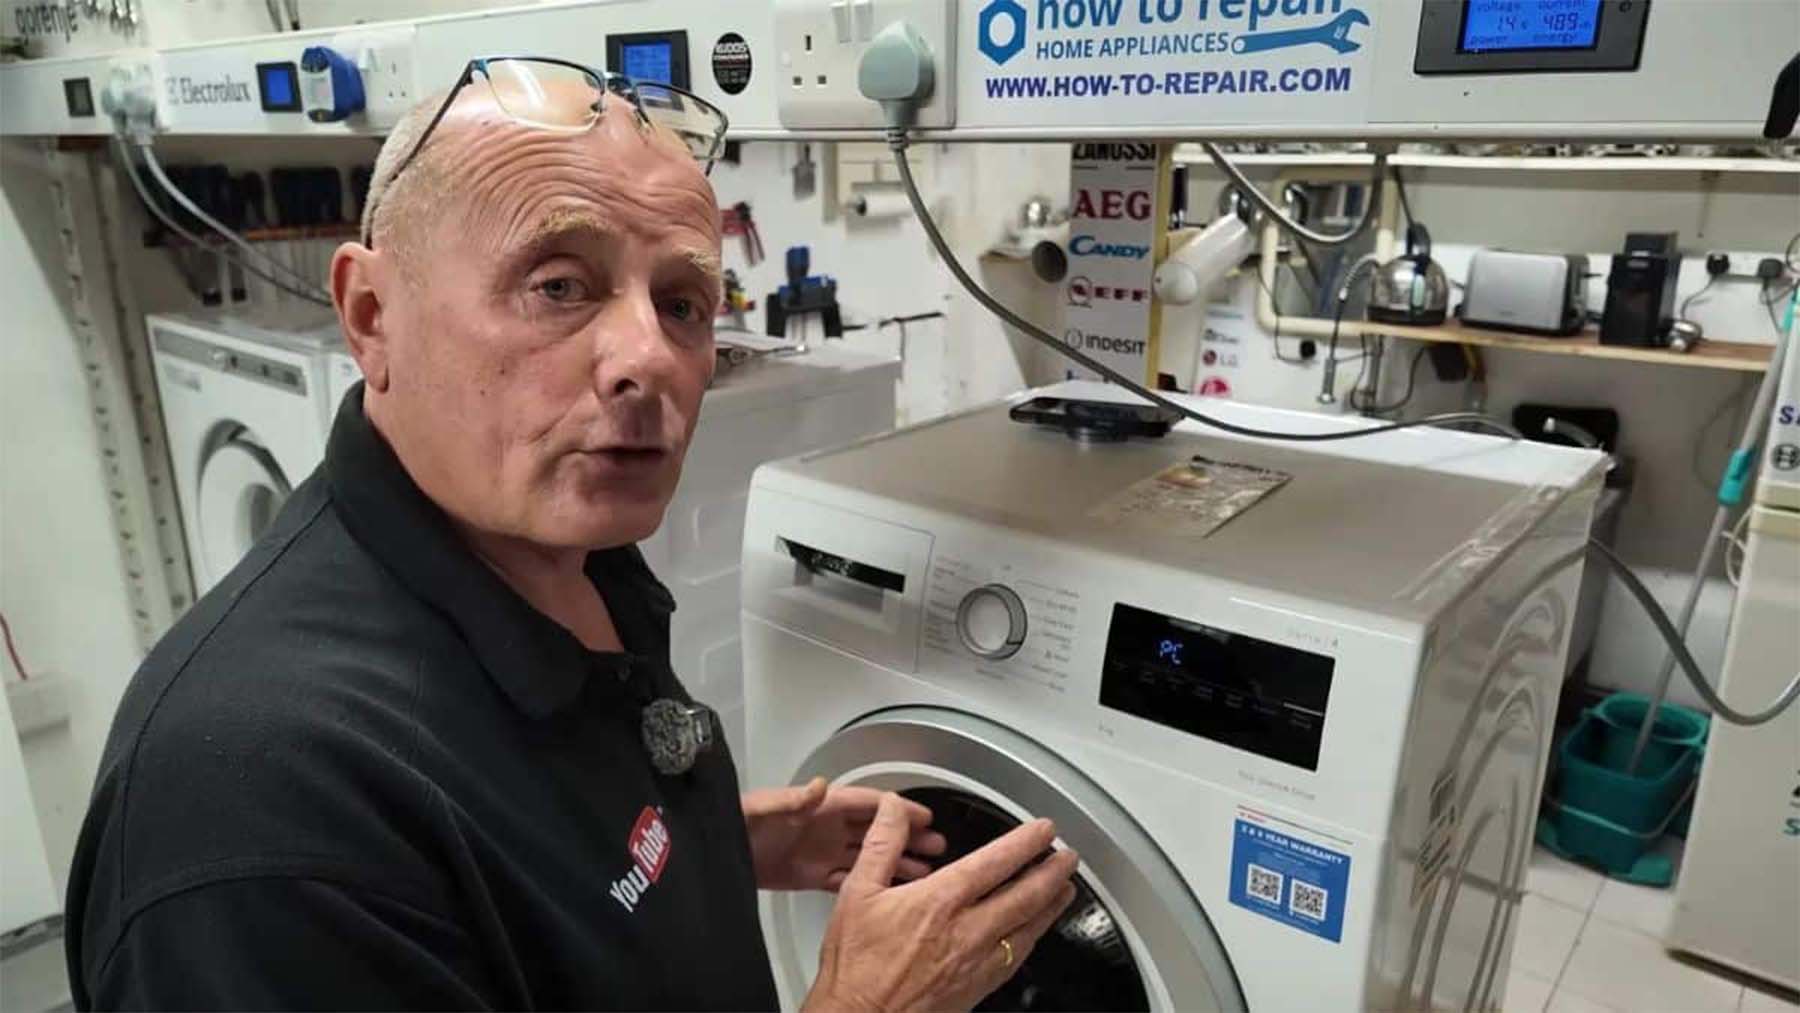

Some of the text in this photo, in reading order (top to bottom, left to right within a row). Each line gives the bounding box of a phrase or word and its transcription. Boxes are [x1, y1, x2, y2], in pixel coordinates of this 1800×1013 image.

[1037, 0, 1122, 30] how
[1037, 31, 1229, 60] HOME APPLIANCES
[179, 74, 252, 105] Electrolux
[985, 67, 1352, 99] WWW.HOW-TO-REPAIR.COM
[1072, 188, 1152, 221] AEG
[609, 818, 669, 913] YouTube
[1290, 840, 1344, 864] WARRANTY
